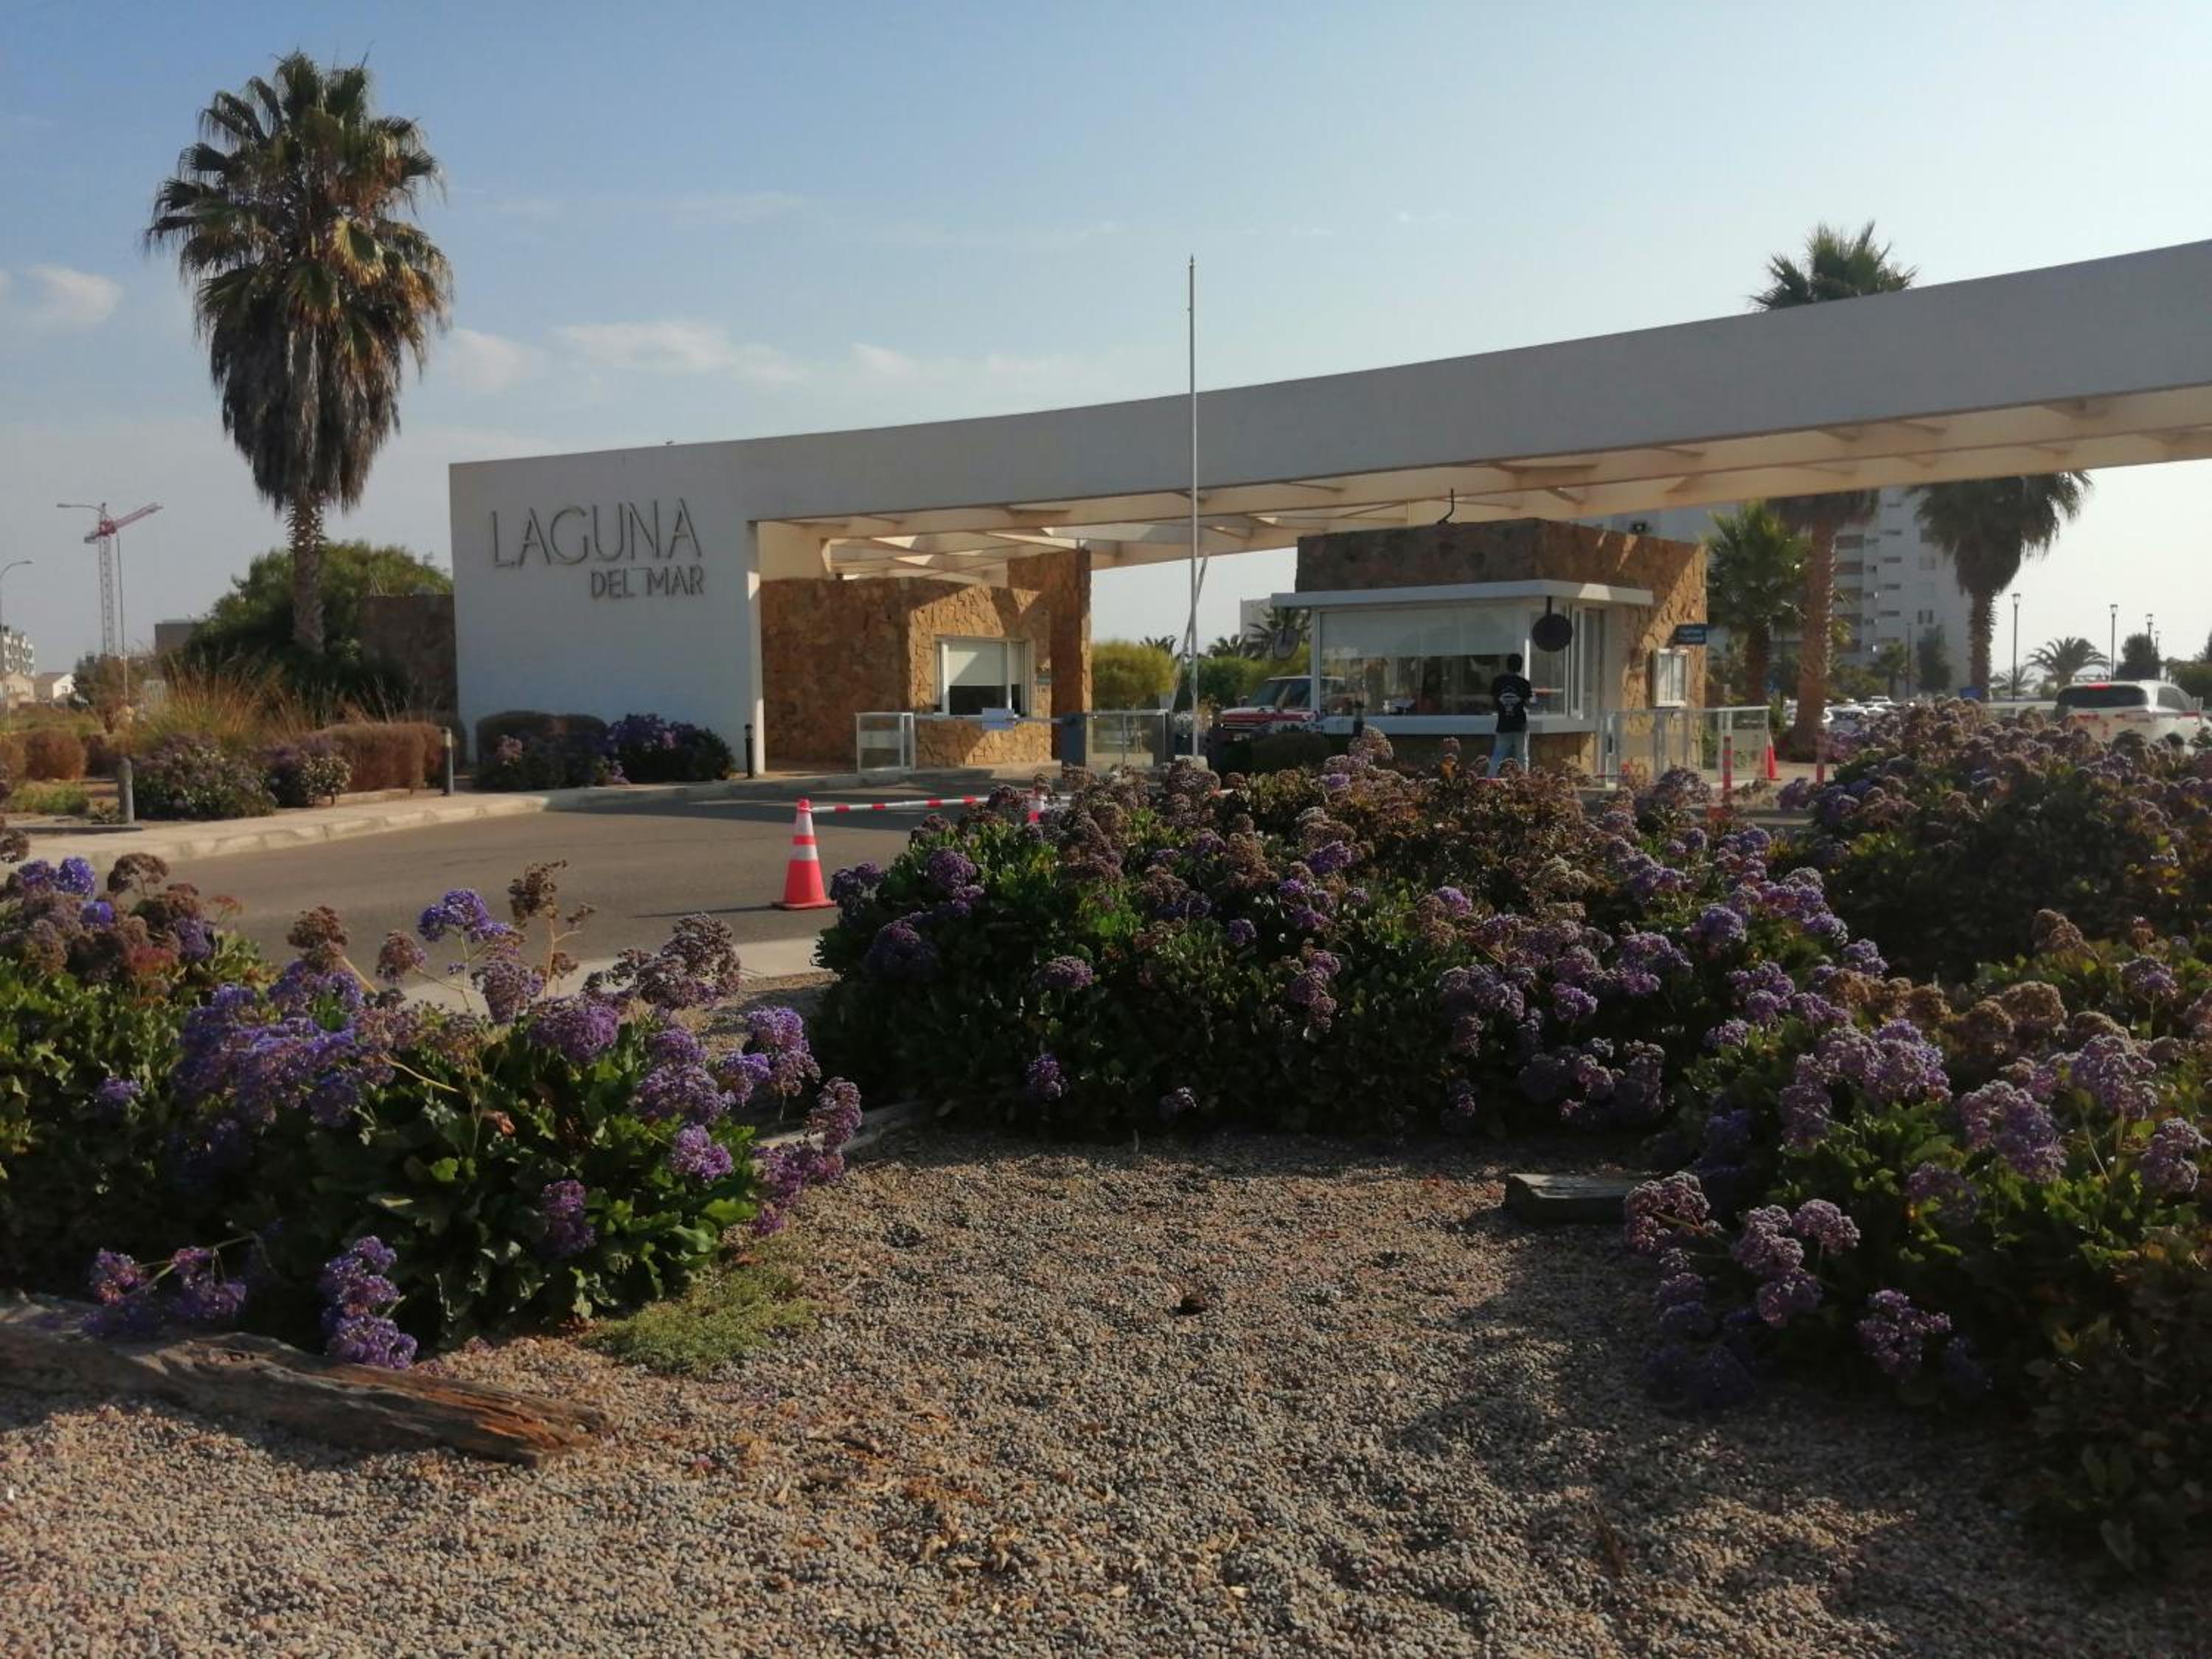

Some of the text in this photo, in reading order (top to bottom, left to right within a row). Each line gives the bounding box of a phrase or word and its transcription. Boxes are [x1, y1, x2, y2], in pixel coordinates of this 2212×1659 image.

[492, 498, 702, 567] LAGUNA
[591, 565, 705, 599] DEL MAR
